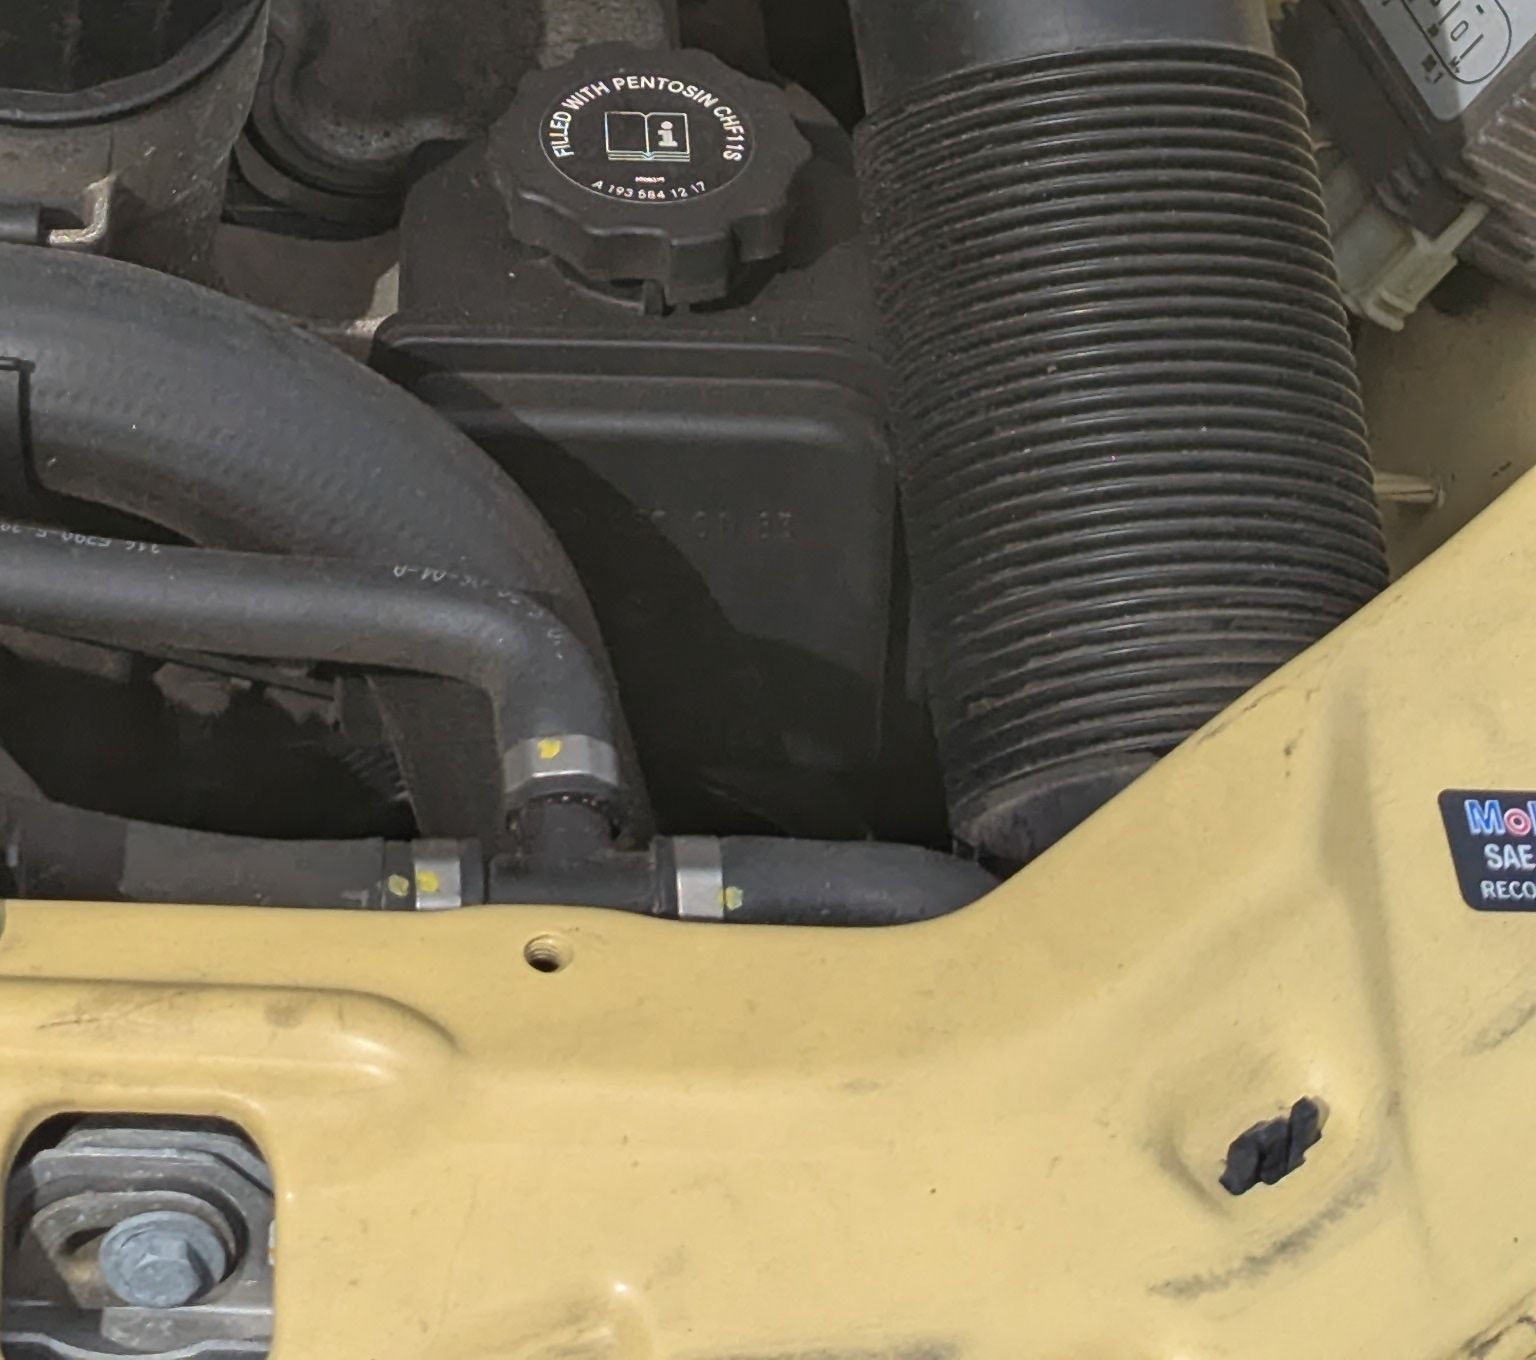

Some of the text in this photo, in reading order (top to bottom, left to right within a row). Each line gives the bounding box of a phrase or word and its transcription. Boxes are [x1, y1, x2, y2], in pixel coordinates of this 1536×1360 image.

[549, 75, 745, 162] FILLED WITH PENTOSIN CHF11S
[592, 180, 603, 190] A
[608, 184, 634, 198] 193
[670, 187, 688, 199] 12
[689, 180, 707, 193] 17
[1463, 799, 1536, 837] Mo
[1483, 843, 1536, 871] SAE
